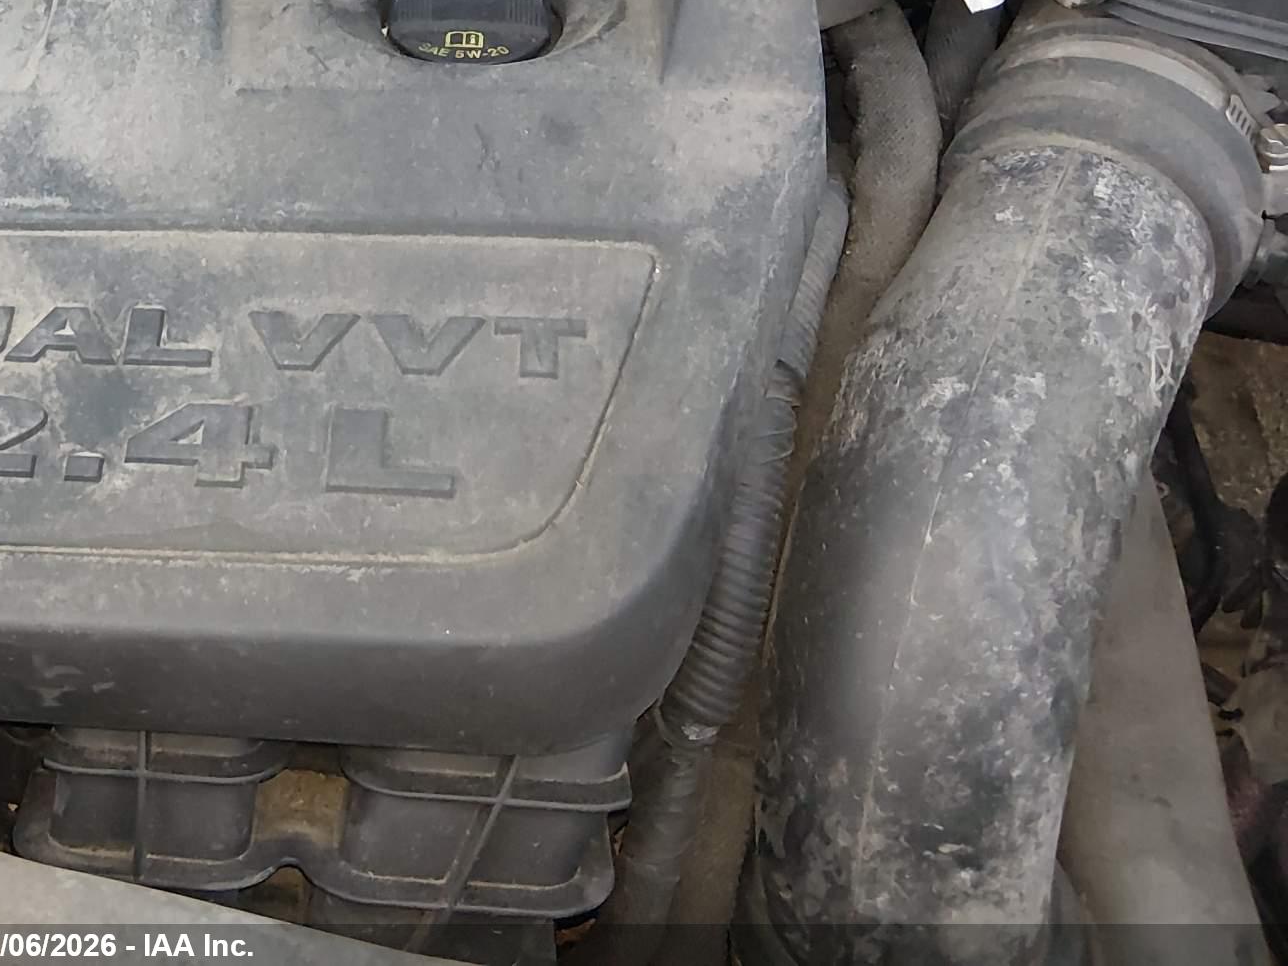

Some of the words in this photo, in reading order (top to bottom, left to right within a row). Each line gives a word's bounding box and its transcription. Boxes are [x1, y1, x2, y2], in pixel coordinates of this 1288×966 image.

[418, 42, 450, 57] SAE
[455, 46, 510, 59] 5W-20
[248, 310, 587, 379] VVT
